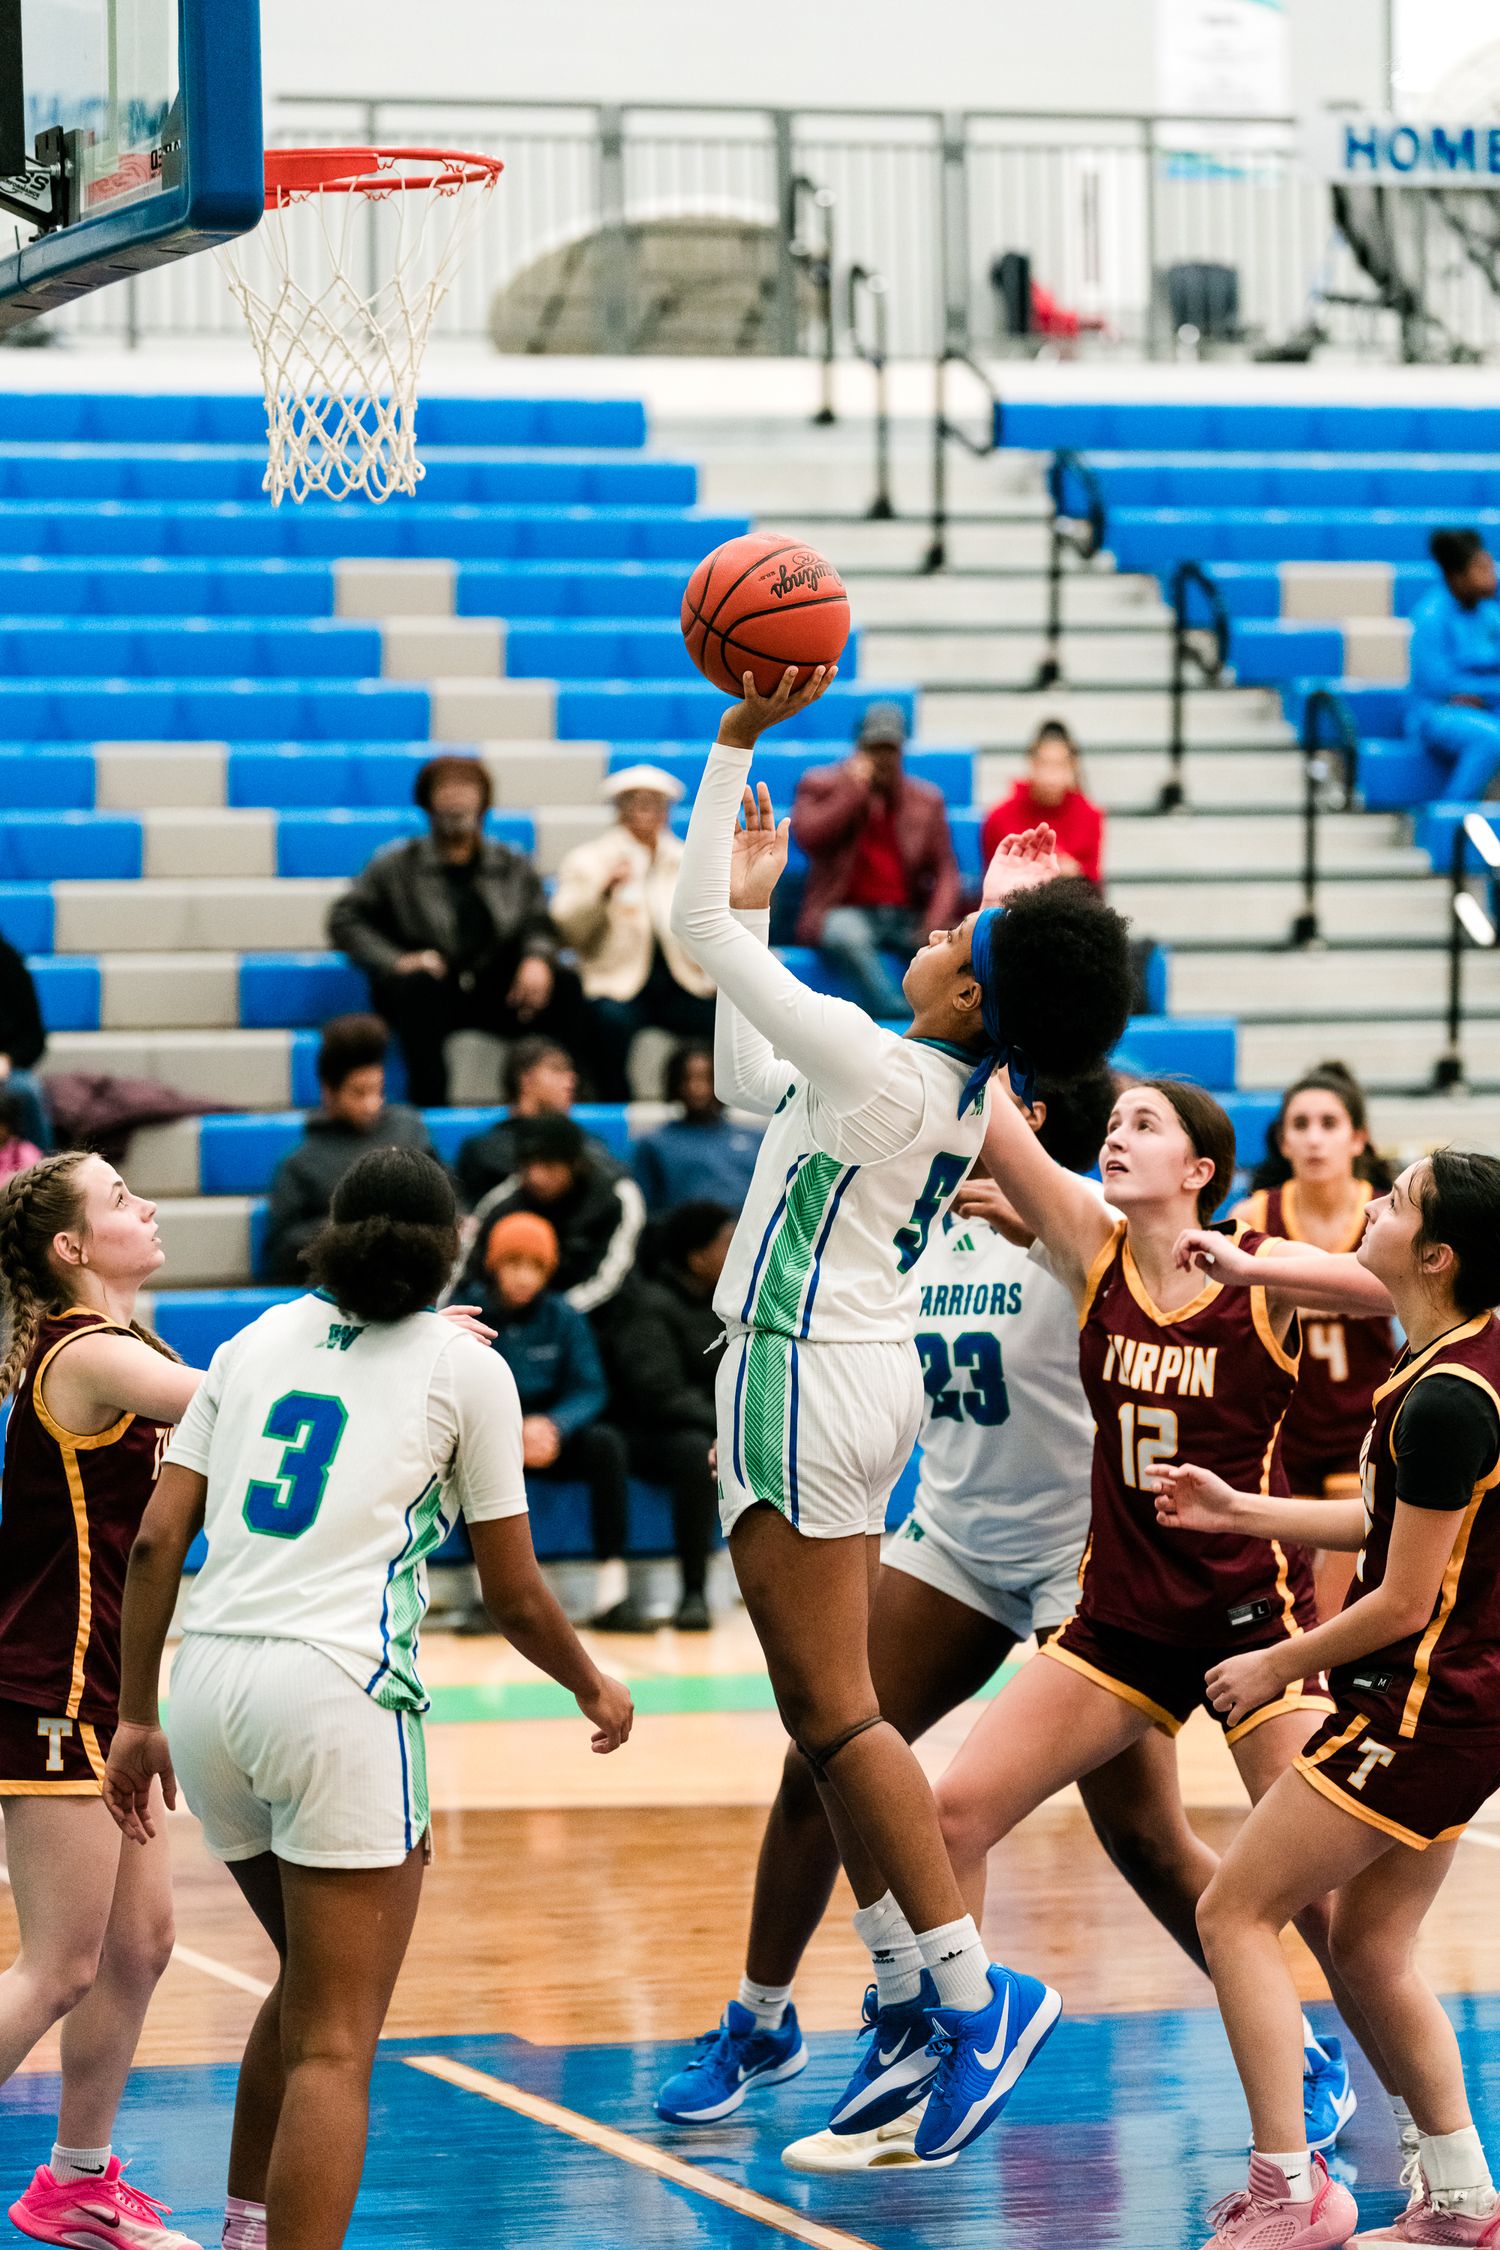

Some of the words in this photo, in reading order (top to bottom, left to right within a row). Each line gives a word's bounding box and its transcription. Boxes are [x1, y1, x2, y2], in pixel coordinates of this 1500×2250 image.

[892, 1151, 972, 1275] 5
[919, 1282, 1022, 1317] ARRIORS
[914, 1331, 1011, 1427] 23
[1102, 1334, 1218, 1398] TURPIN
[1308, 1322, 1350, 1383] 4
[242, 1389, 349, 1540] 3
[1118, 1401, 1178, 1491] 12
[37, 1717, 73, 1772] T
[1347, 1736, 1397, 1792] T
